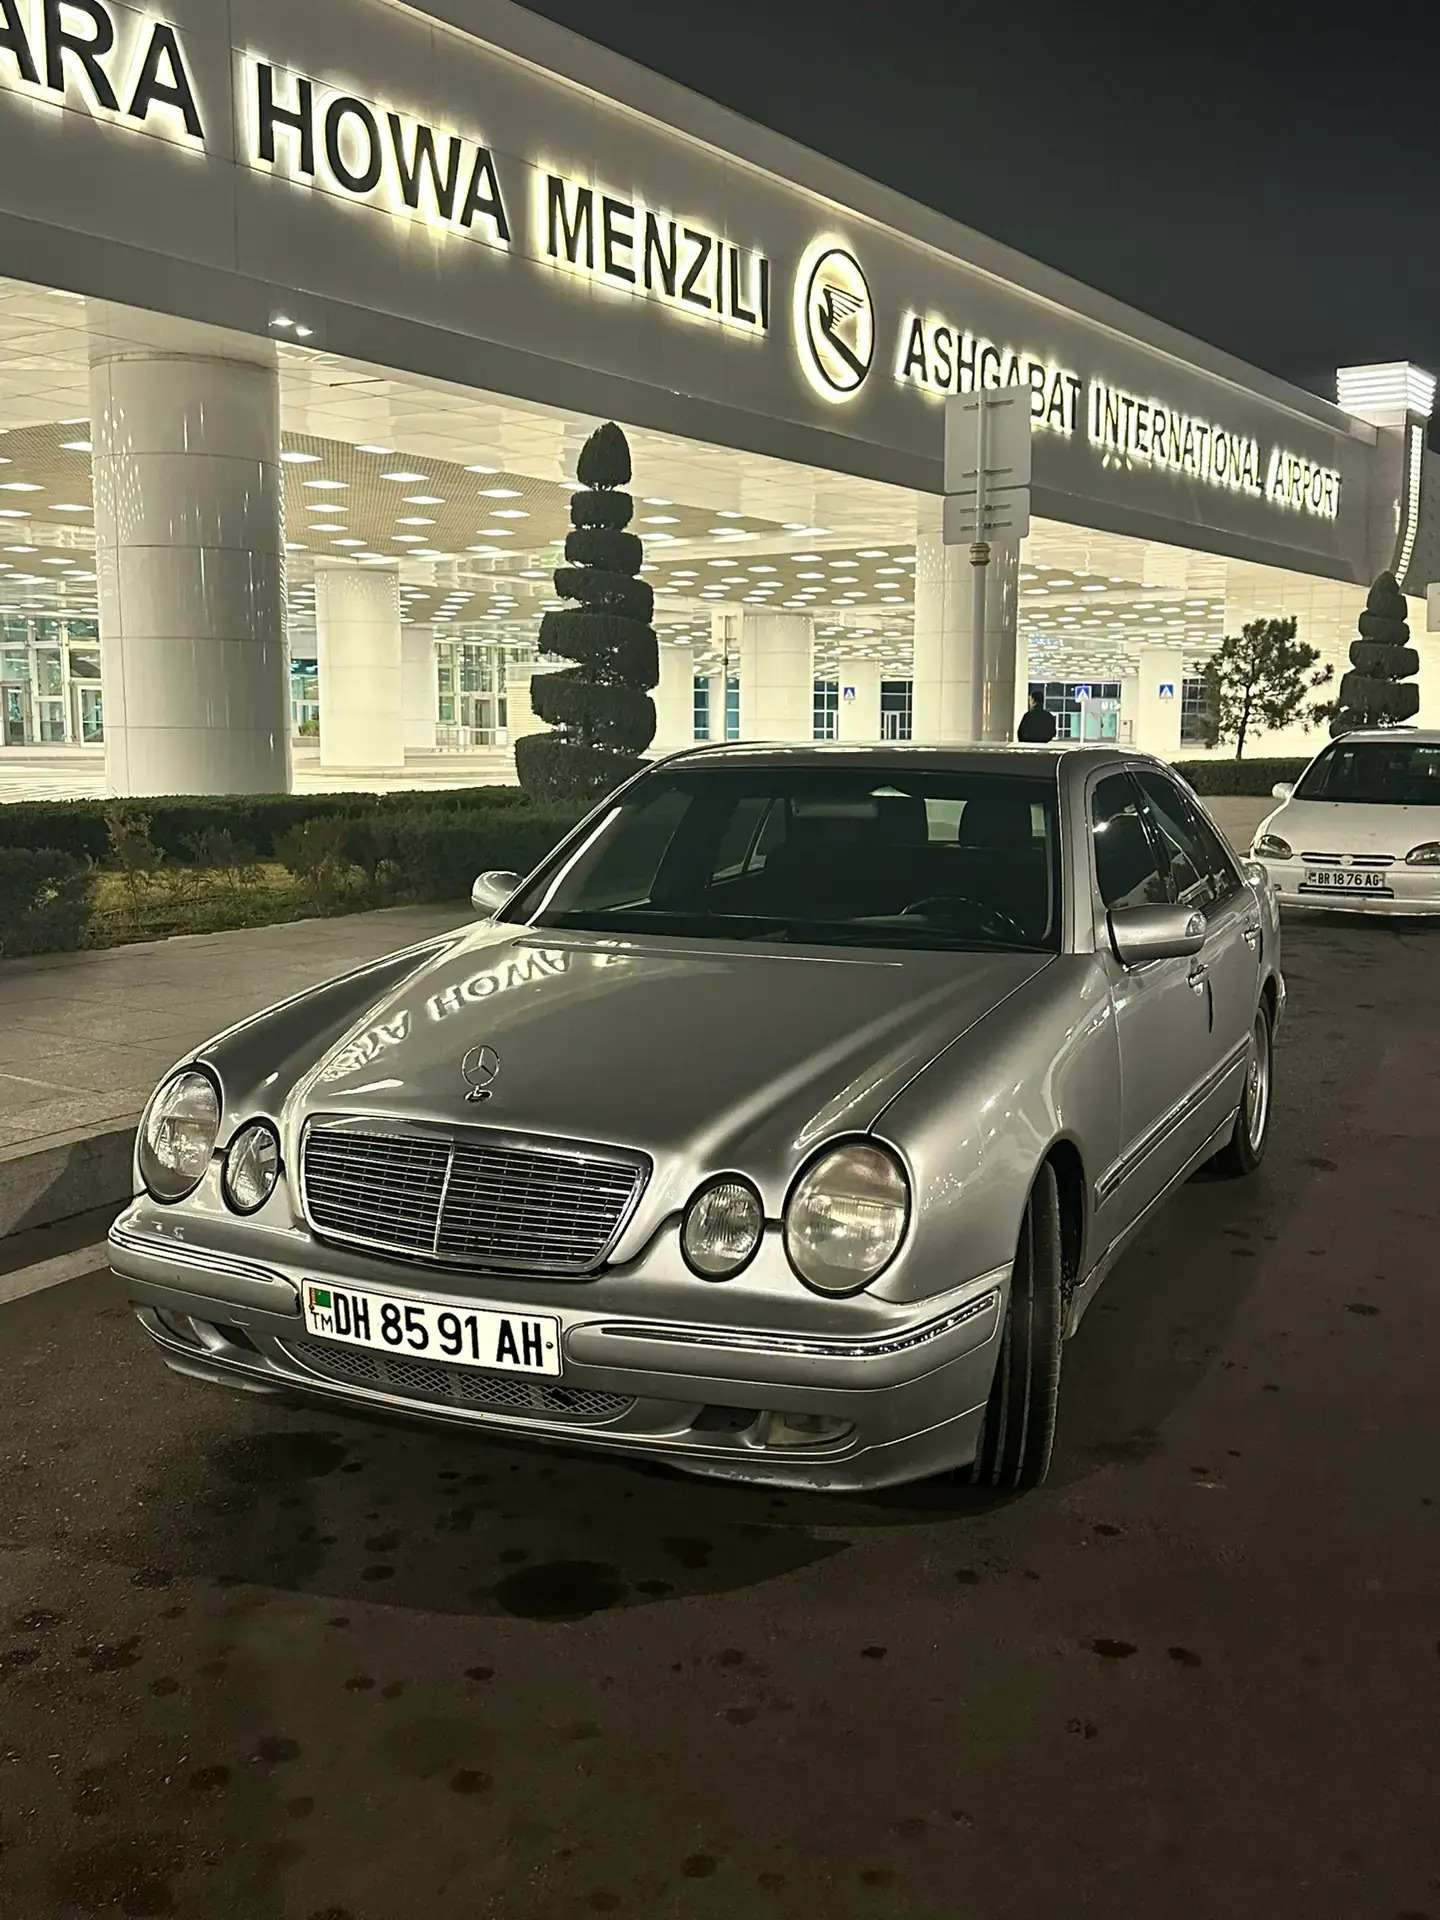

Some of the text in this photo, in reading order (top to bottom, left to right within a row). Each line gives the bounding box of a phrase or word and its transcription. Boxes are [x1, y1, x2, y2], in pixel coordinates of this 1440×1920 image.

[257, 62, 511, 242] HOWA
[546, 176, 770, 330] MENZILI
[1095, 387, 1265, 490] INTERNATIONAL
[1273, 452, 1342, 518] AIRPORT
[1318, 872, 1330, 885] BR
[1365, 874, 1379, 886] AG
[311, 1310, 333, 1333] TM
[333, 1291, 544, 1367] DH 85 91 AH
